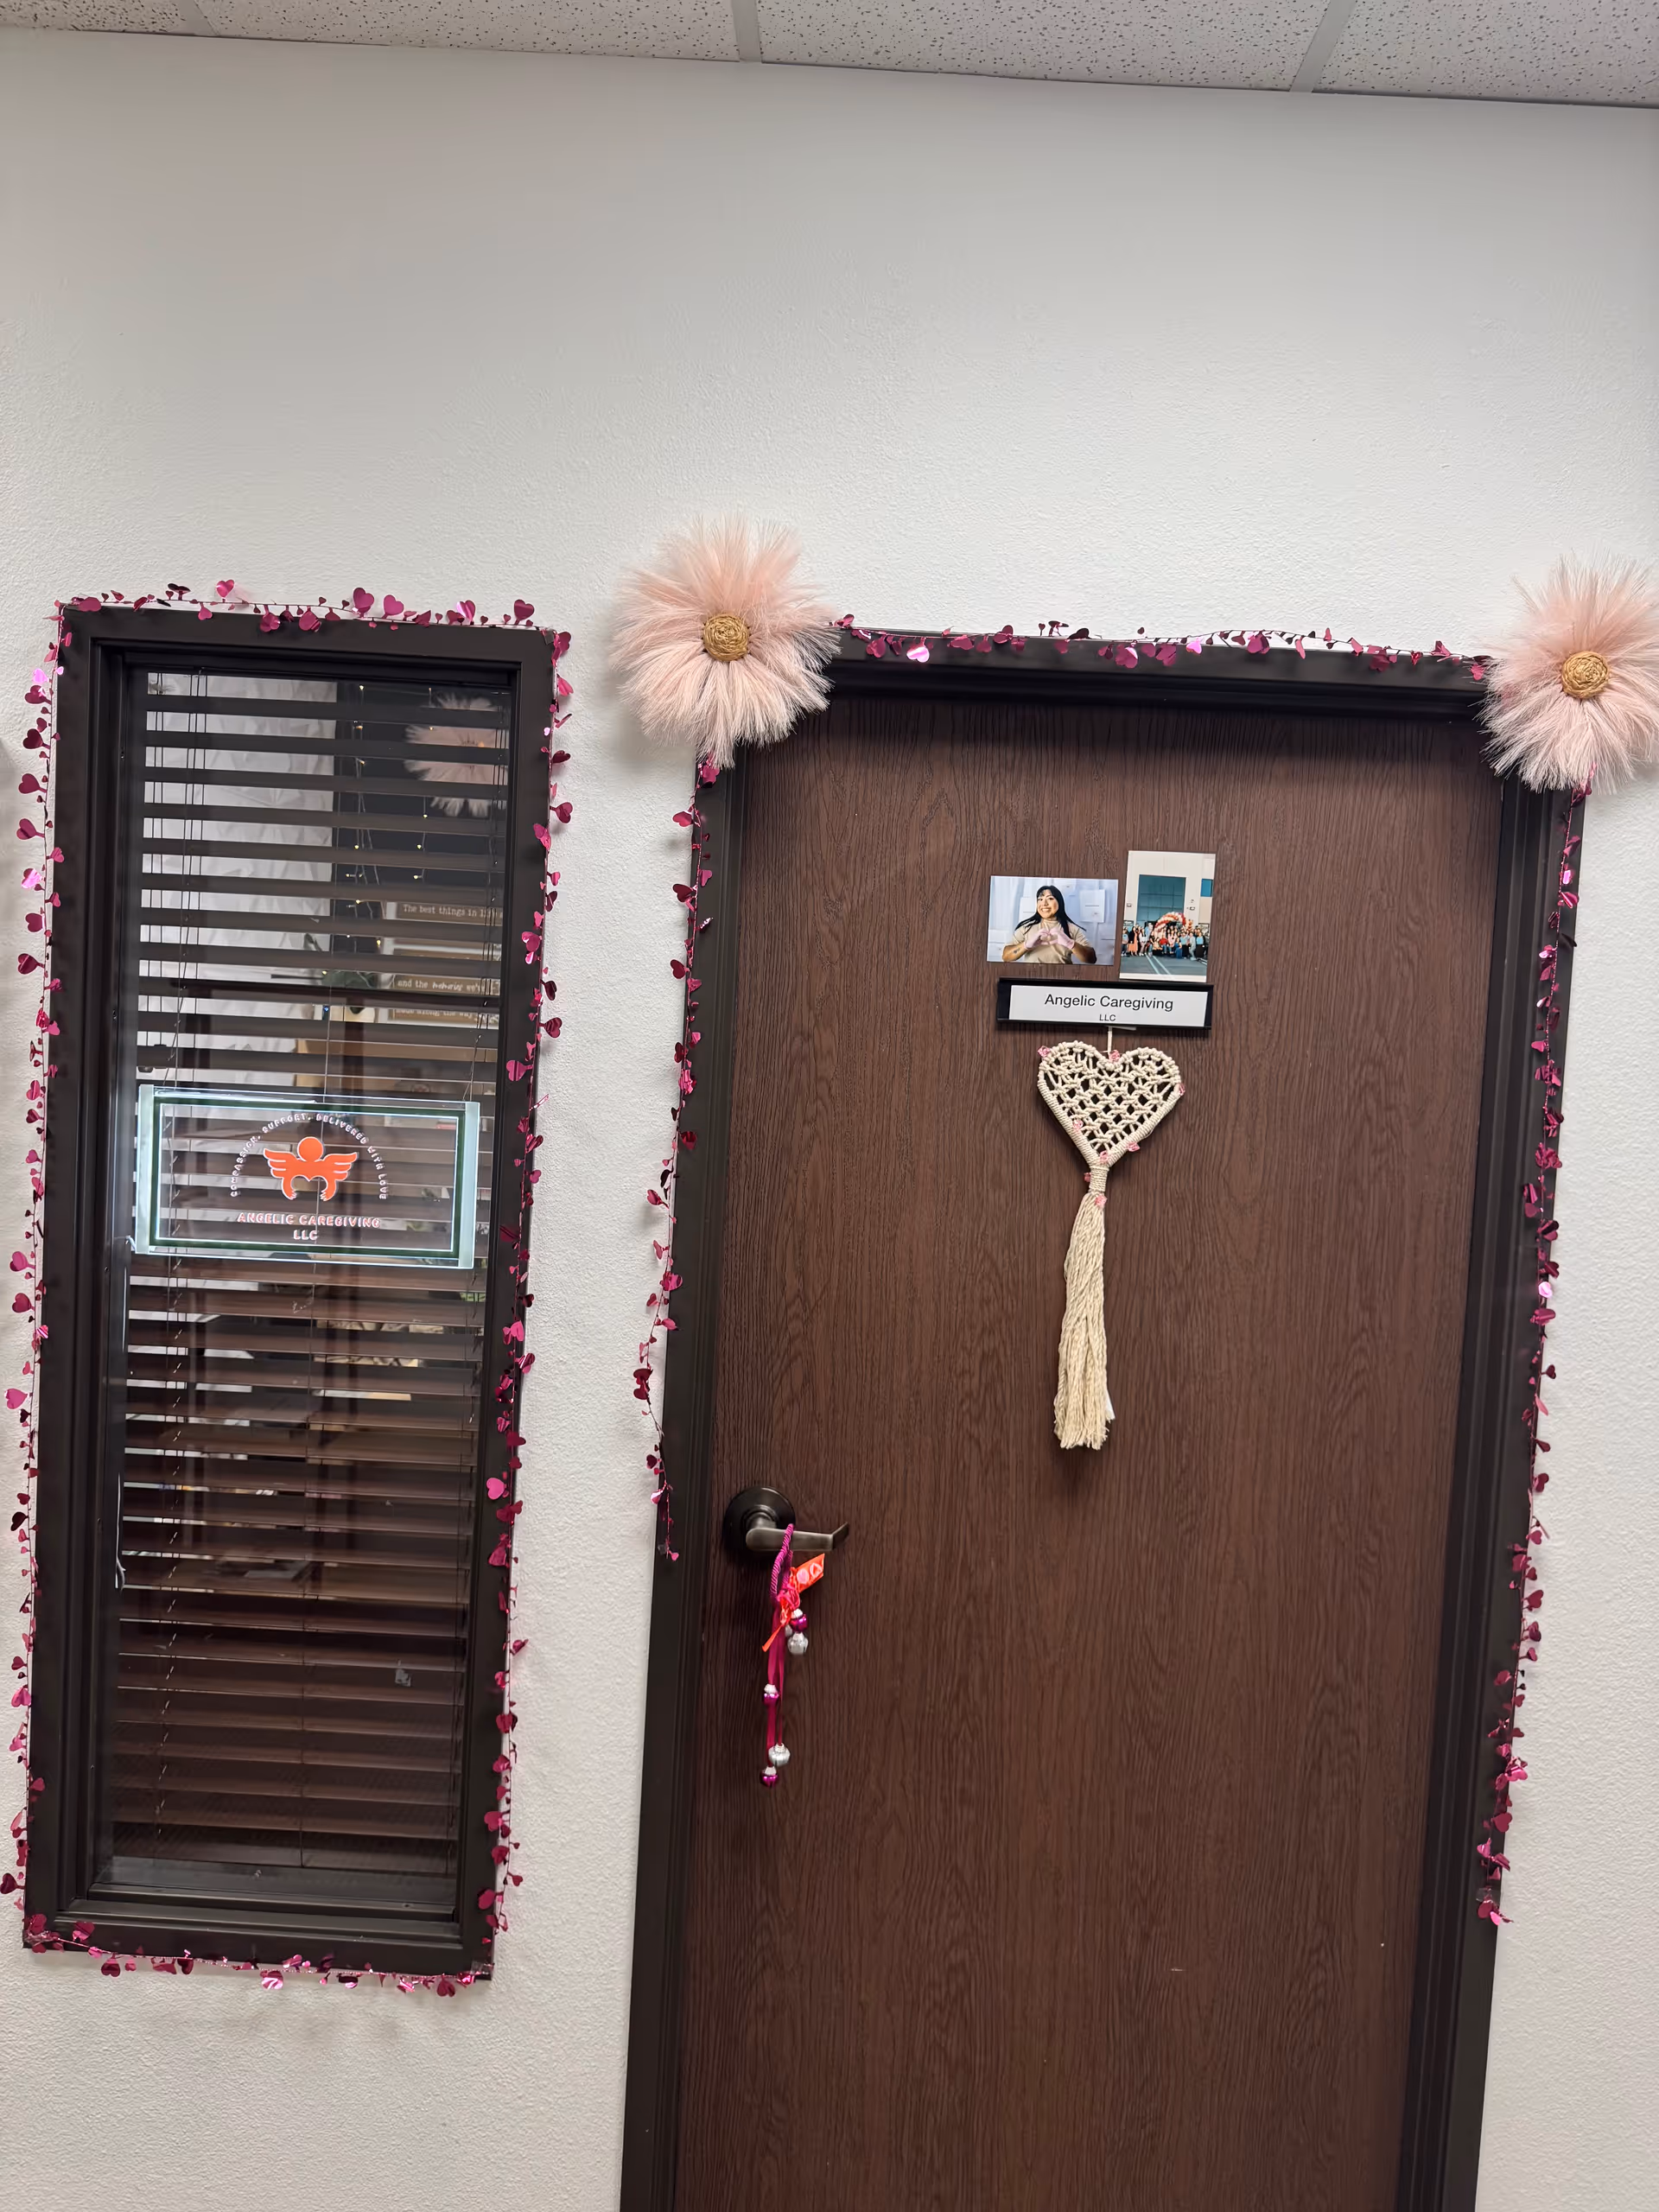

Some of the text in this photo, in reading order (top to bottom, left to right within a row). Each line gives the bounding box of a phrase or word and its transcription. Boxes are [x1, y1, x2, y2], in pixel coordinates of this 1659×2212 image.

[403, 904, 416, 912] The
[419, 906, 435, 914] best
[439, 906, 465, 917] things
[397, 979, 412, 988] and
[415, 980, 429, 989] the
[1044, 994, 1173, 1012] Angelic Caregiving
[1099, 1014, 1116, 1022] LLC
[315, 1113, 368, 1145] DELIVERED
[367, 1146, 385, 1170] WITH
[378, 1173, 388, 1200] LOVE
[237, 1212, 381, 1228] ANGELIC CAREGIVING
[293, 1230, 318, 1241] LLC
